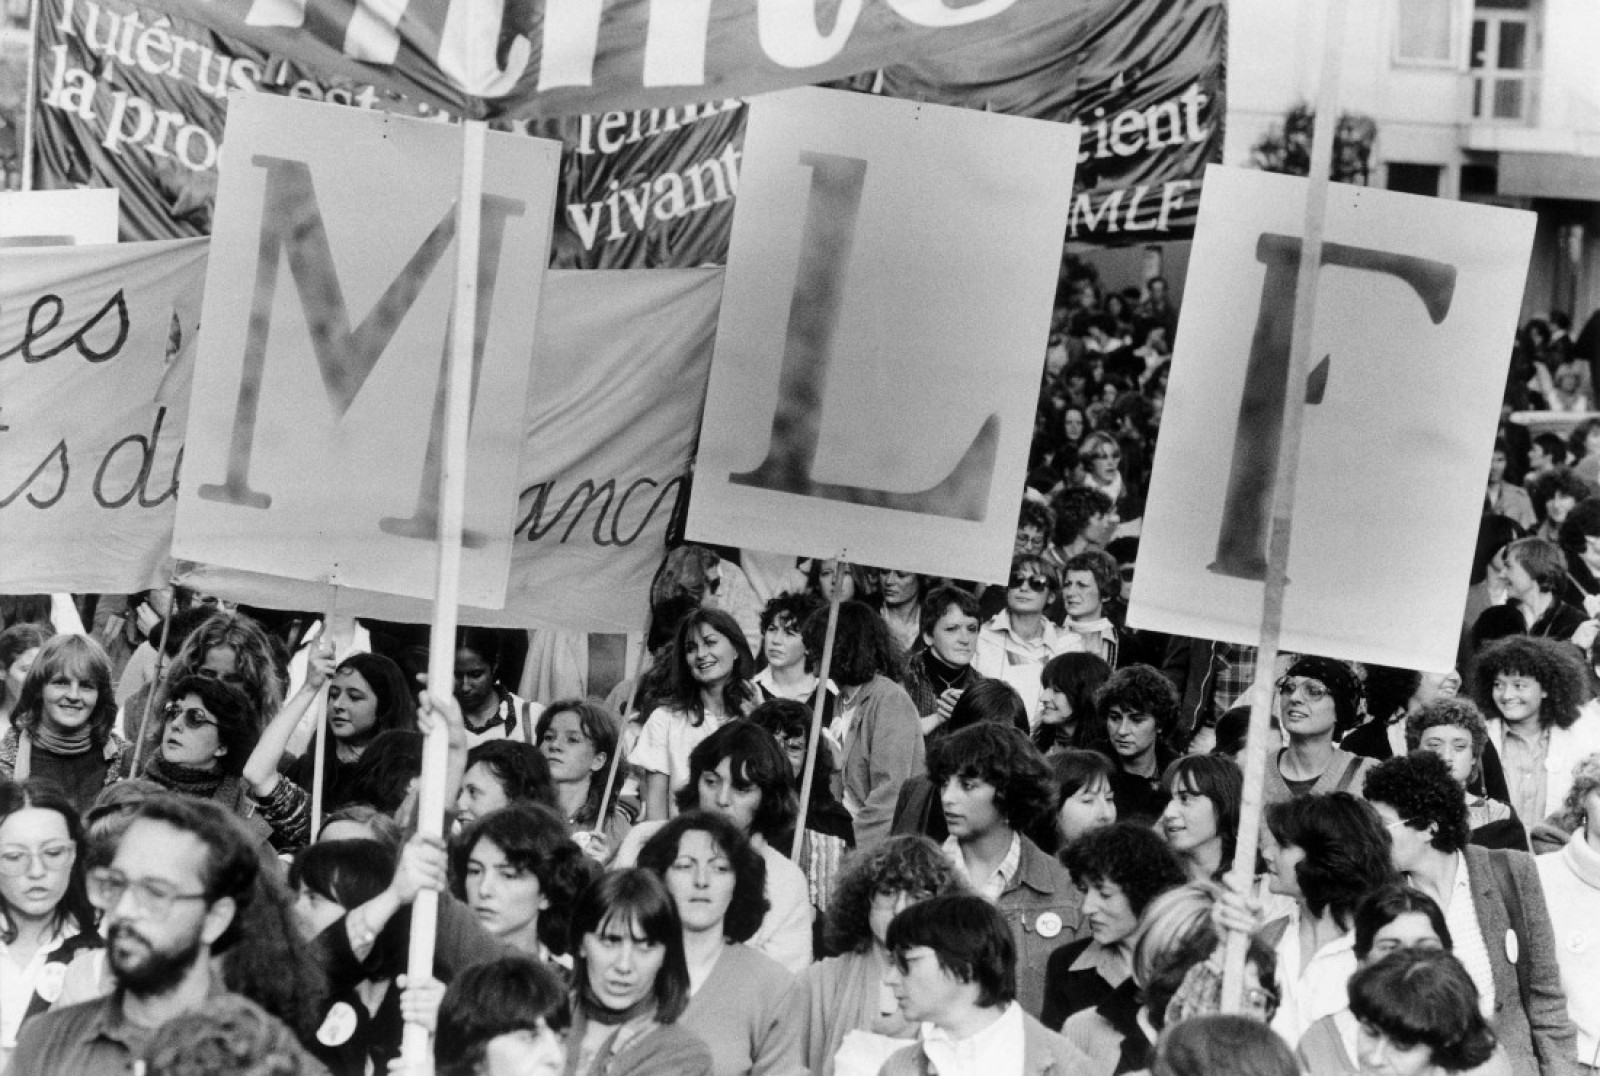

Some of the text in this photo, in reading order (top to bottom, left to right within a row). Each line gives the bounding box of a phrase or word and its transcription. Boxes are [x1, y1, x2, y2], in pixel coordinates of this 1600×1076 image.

[43, 44, 97, 120] la
[102, 91, 222, 171] pro
[567, 142, 742, 250] vivant
[1069, 180, 1192, 237] MLF
[197, 154, 525, 550] M
[729, 150, 1000, 522] L
[1206, 232, 1457, 584] F
